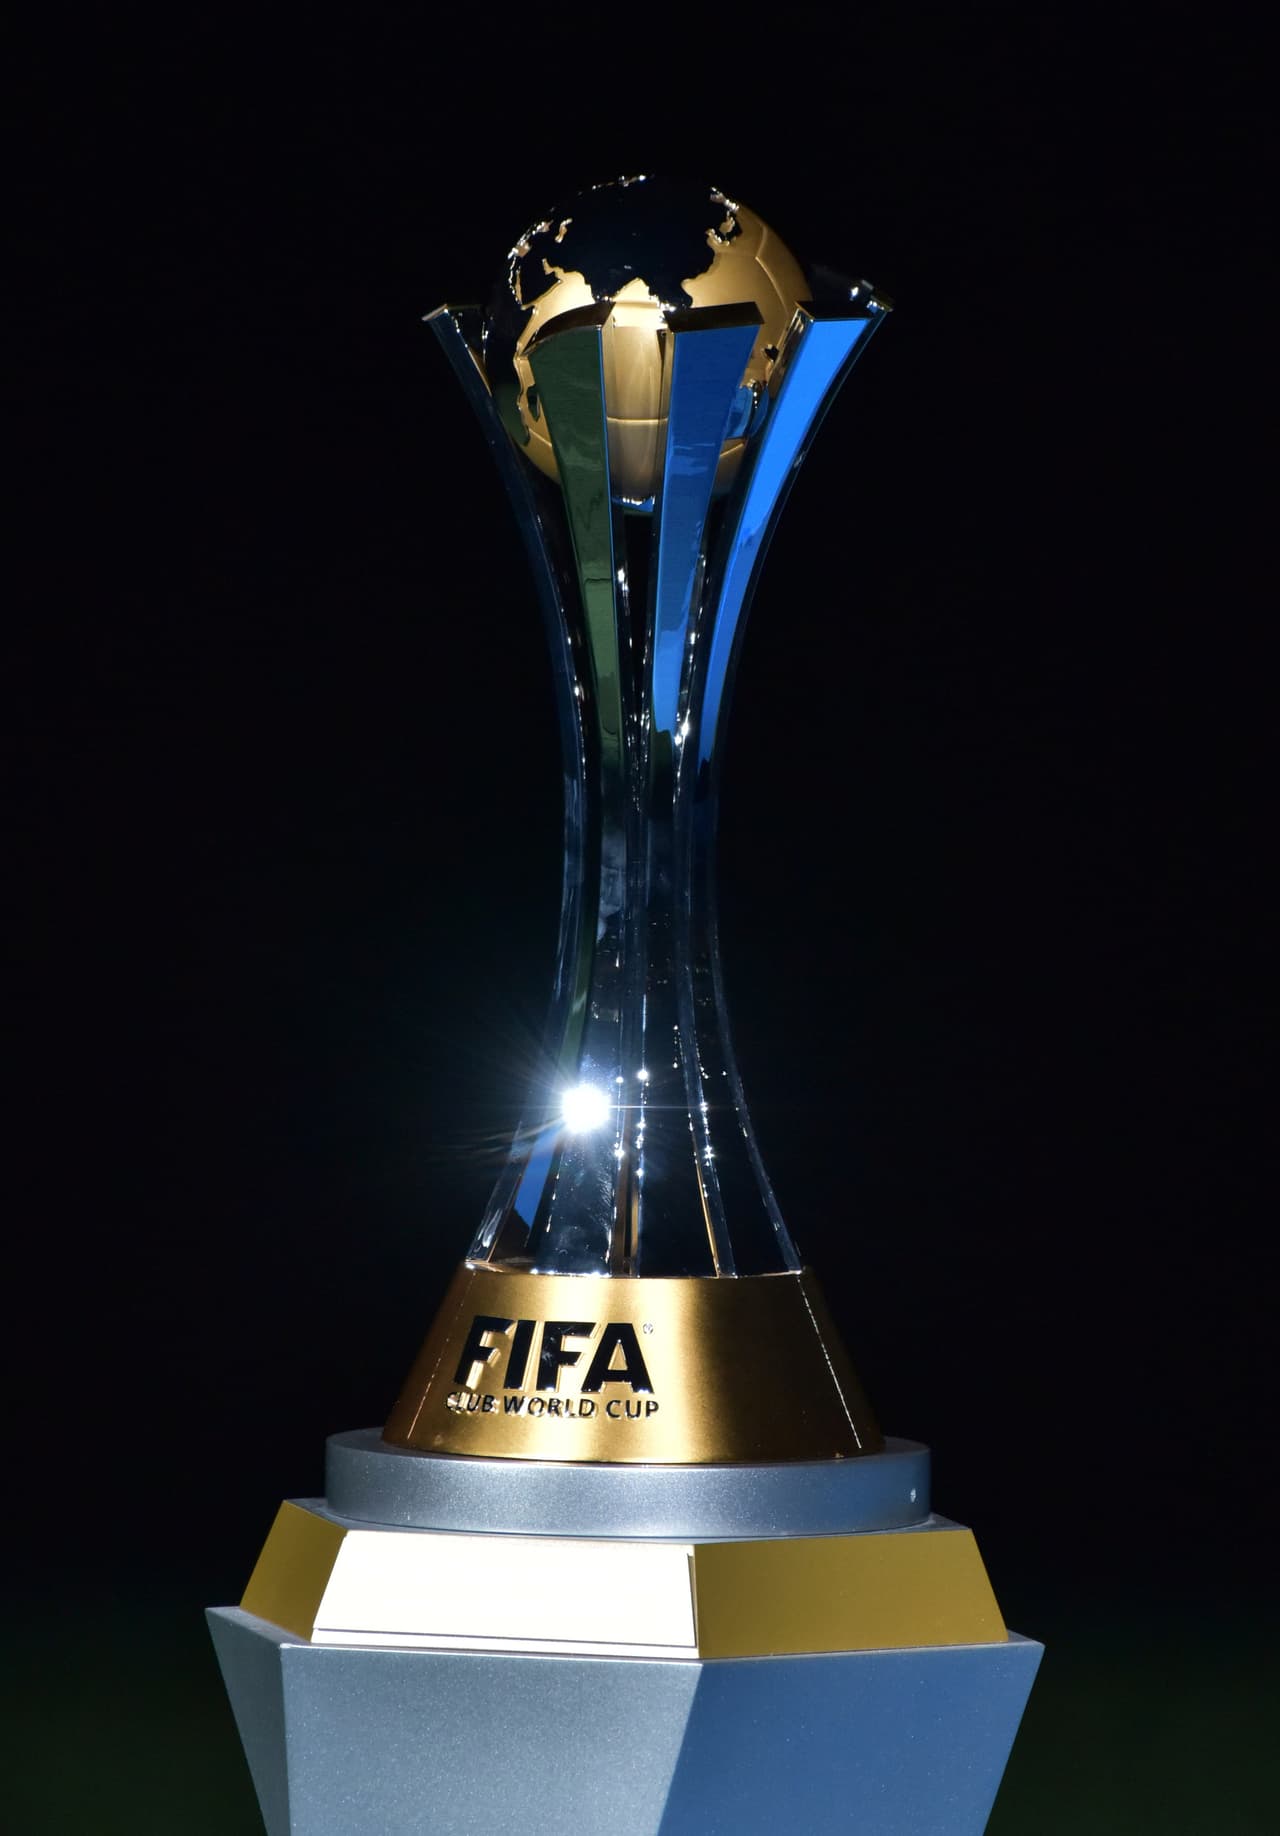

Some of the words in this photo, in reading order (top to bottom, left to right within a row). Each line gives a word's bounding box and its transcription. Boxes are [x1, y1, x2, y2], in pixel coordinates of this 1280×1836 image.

[453, 1315, 654, 1394] FIFA
[446, 1391, 496, 1413] CLUB
[503, 1395, 596, 1418] WORLD
[605, 1399, 659, 1419] CUP
